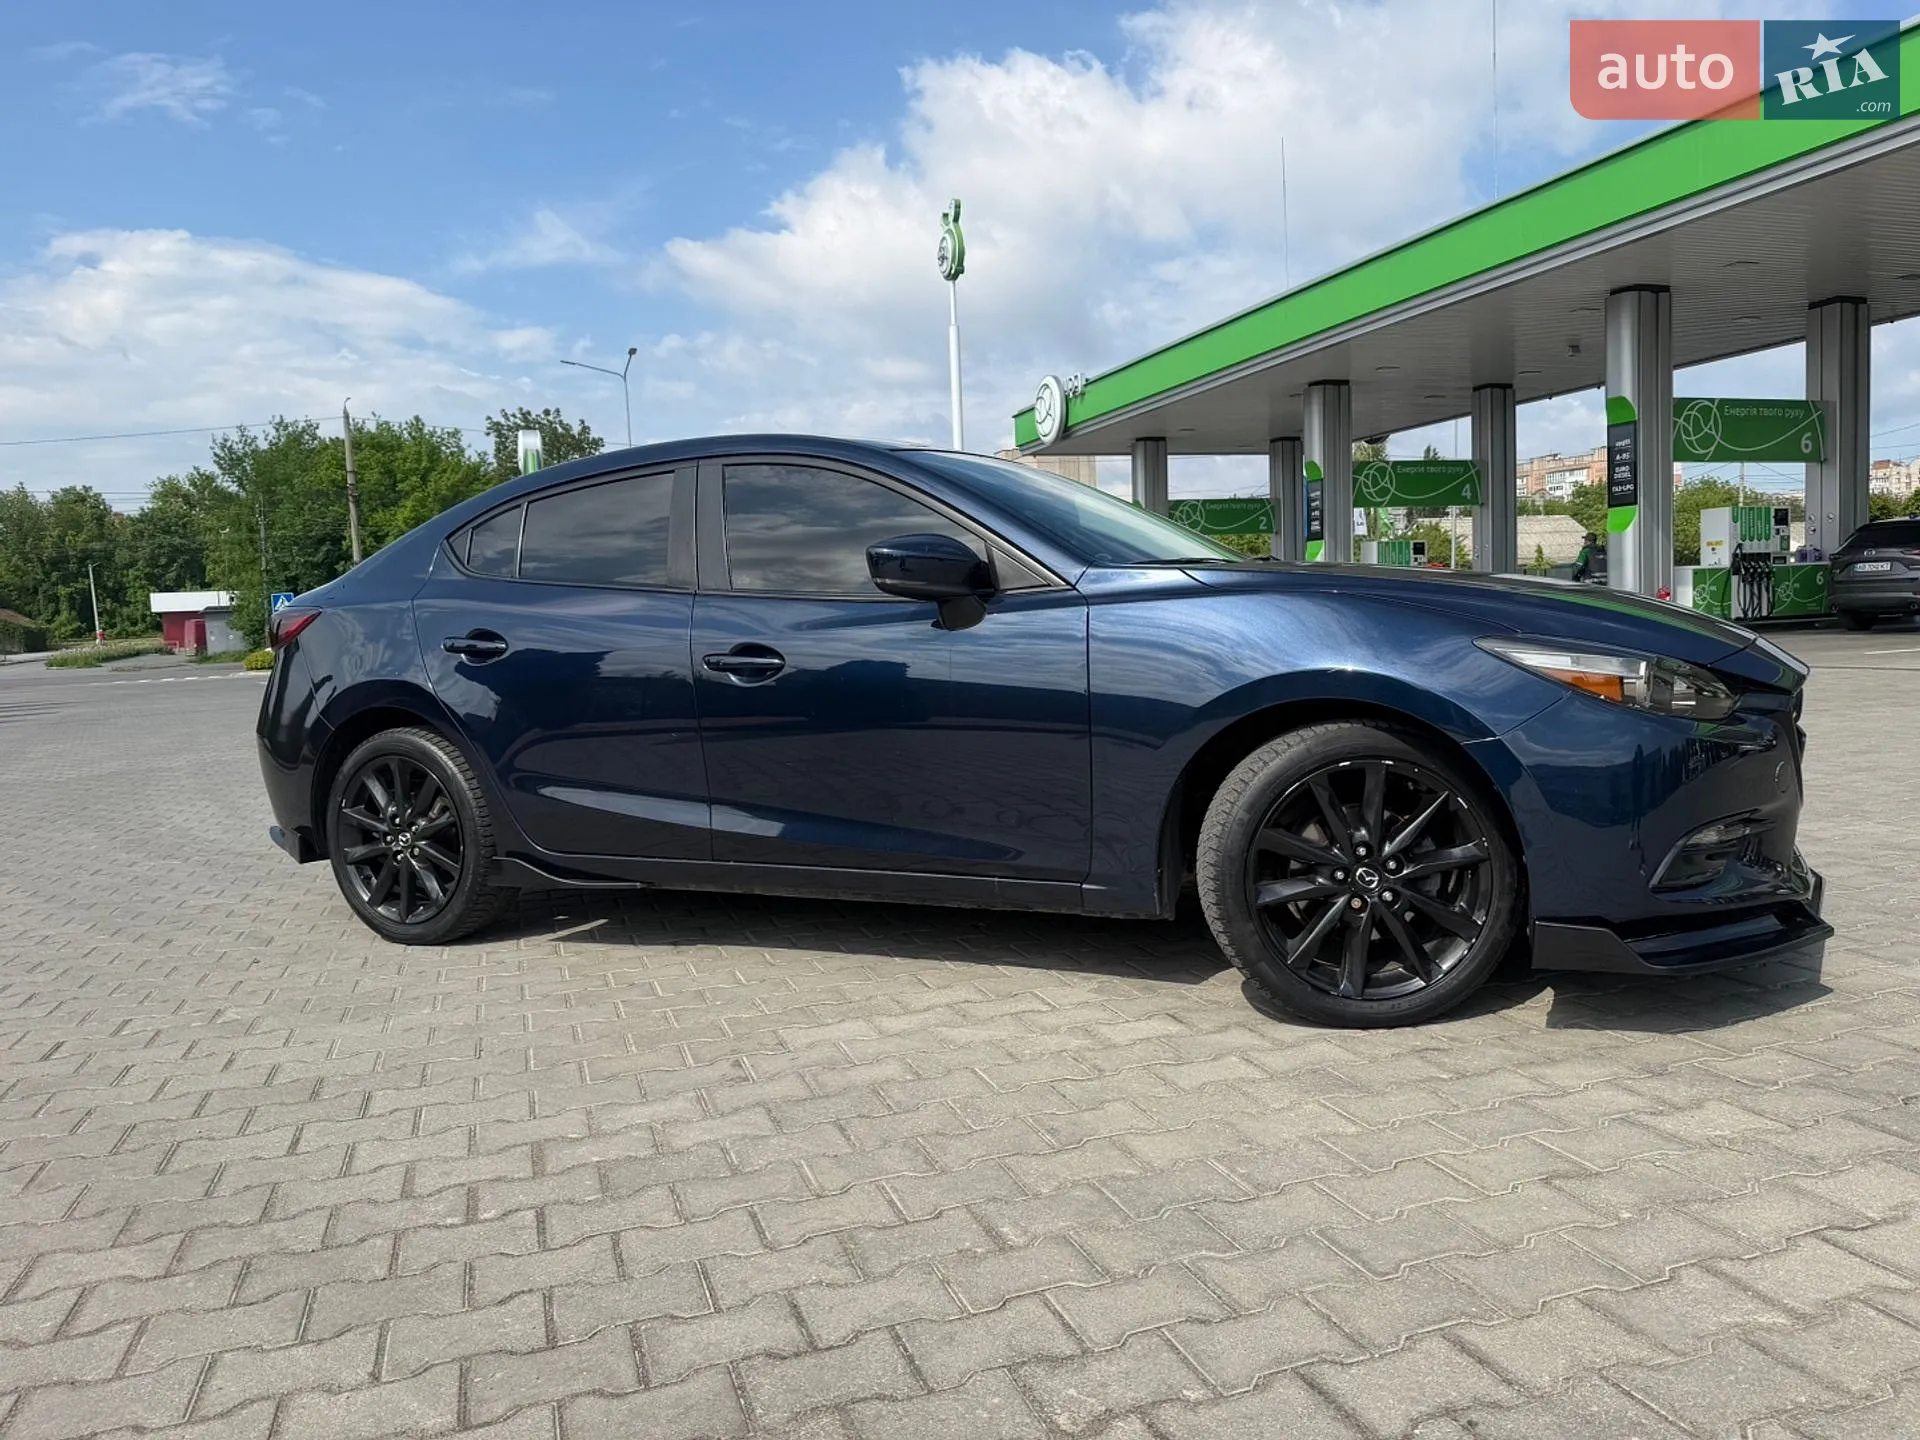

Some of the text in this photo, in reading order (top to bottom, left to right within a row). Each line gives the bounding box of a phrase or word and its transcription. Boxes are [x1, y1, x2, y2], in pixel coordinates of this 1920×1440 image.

[1800, 431, 1813, 454] 6
[1461, 483, 1472, 500] 4
[1258, 516, 1268, 530] 2
[1816, 571, 1824, 585] 6
